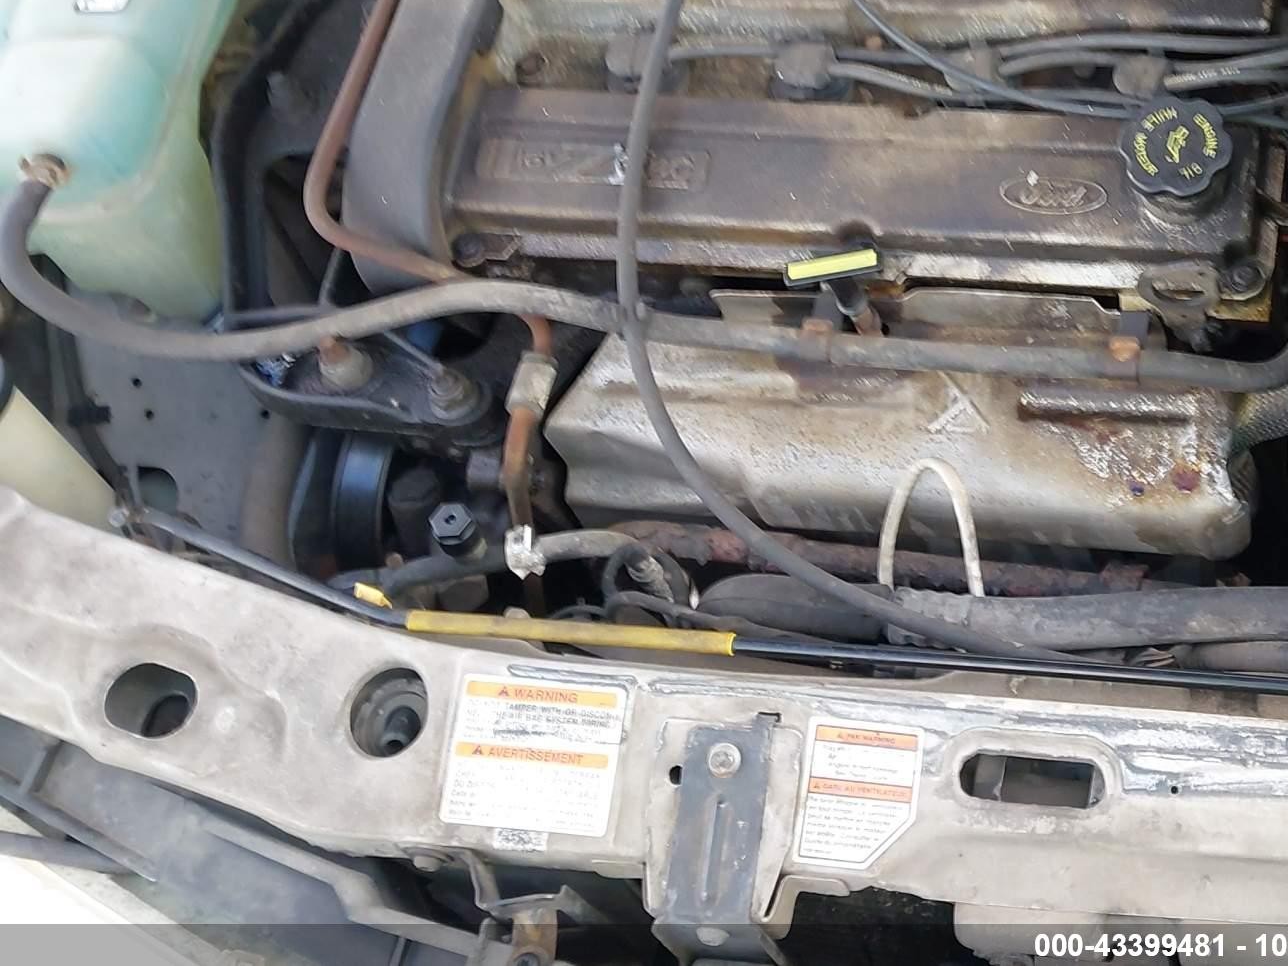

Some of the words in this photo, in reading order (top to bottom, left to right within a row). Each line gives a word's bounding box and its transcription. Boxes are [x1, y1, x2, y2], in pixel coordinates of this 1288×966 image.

[1141, 106, 1178, 132] HUILE
[1192, 113, 1218, 158] ENGINE
[1133, 132, 1159, 176] MOTEUR
[1178, 162, 1203, 181] OIL
[514, 688, 578, 703] WARNING
[488, 748, 583, 766] AVERTISSEMENT
